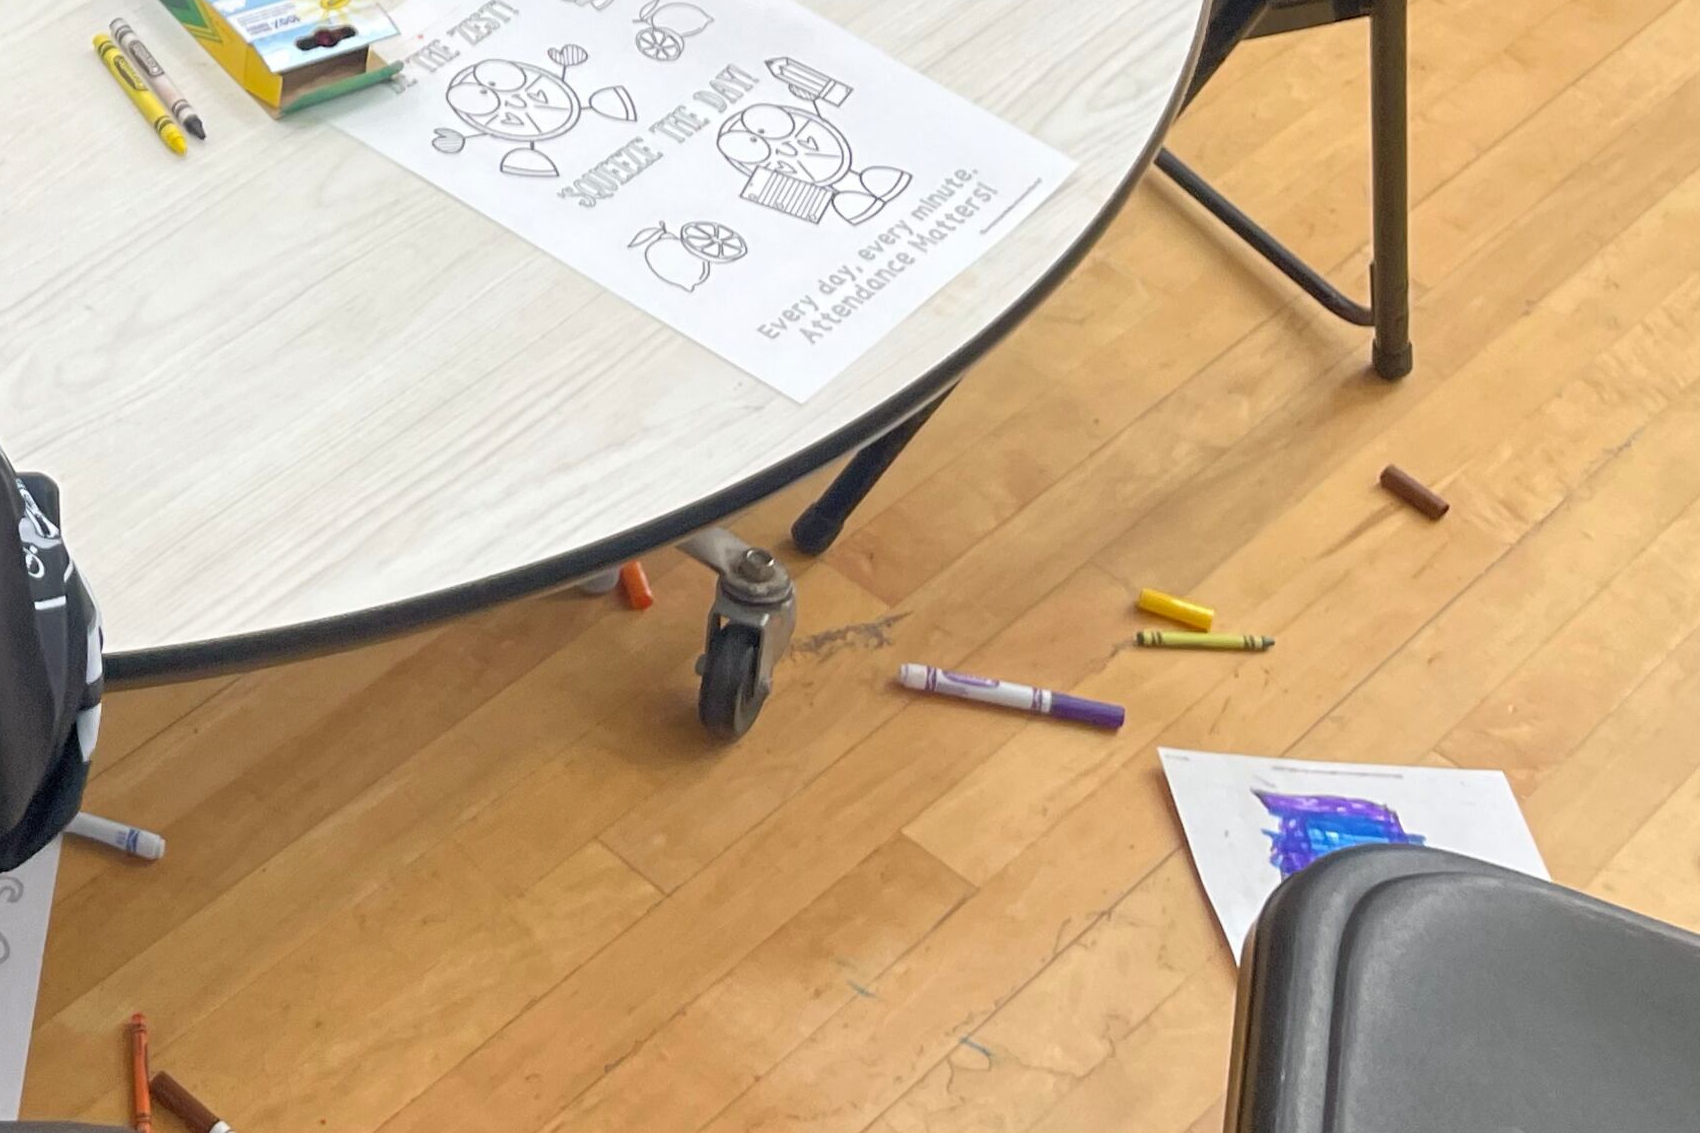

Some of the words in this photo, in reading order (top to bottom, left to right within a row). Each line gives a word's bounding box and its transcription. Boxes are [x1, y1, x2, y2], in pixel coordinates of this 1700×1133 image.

[556, 135, 664, 208] SQUEEZE
[647, 104, 711, 143] THE
[692, 63, 761, 116] DAY!
[756, 293, 820, 340] Every
[817, 263, 865, 296] day,
[856, 217, 914, 262] every
[910, 167, 980, 222] minute.
[798, 249, 917, 346] Attendance
[906, 181, 999, 254] Matters!
